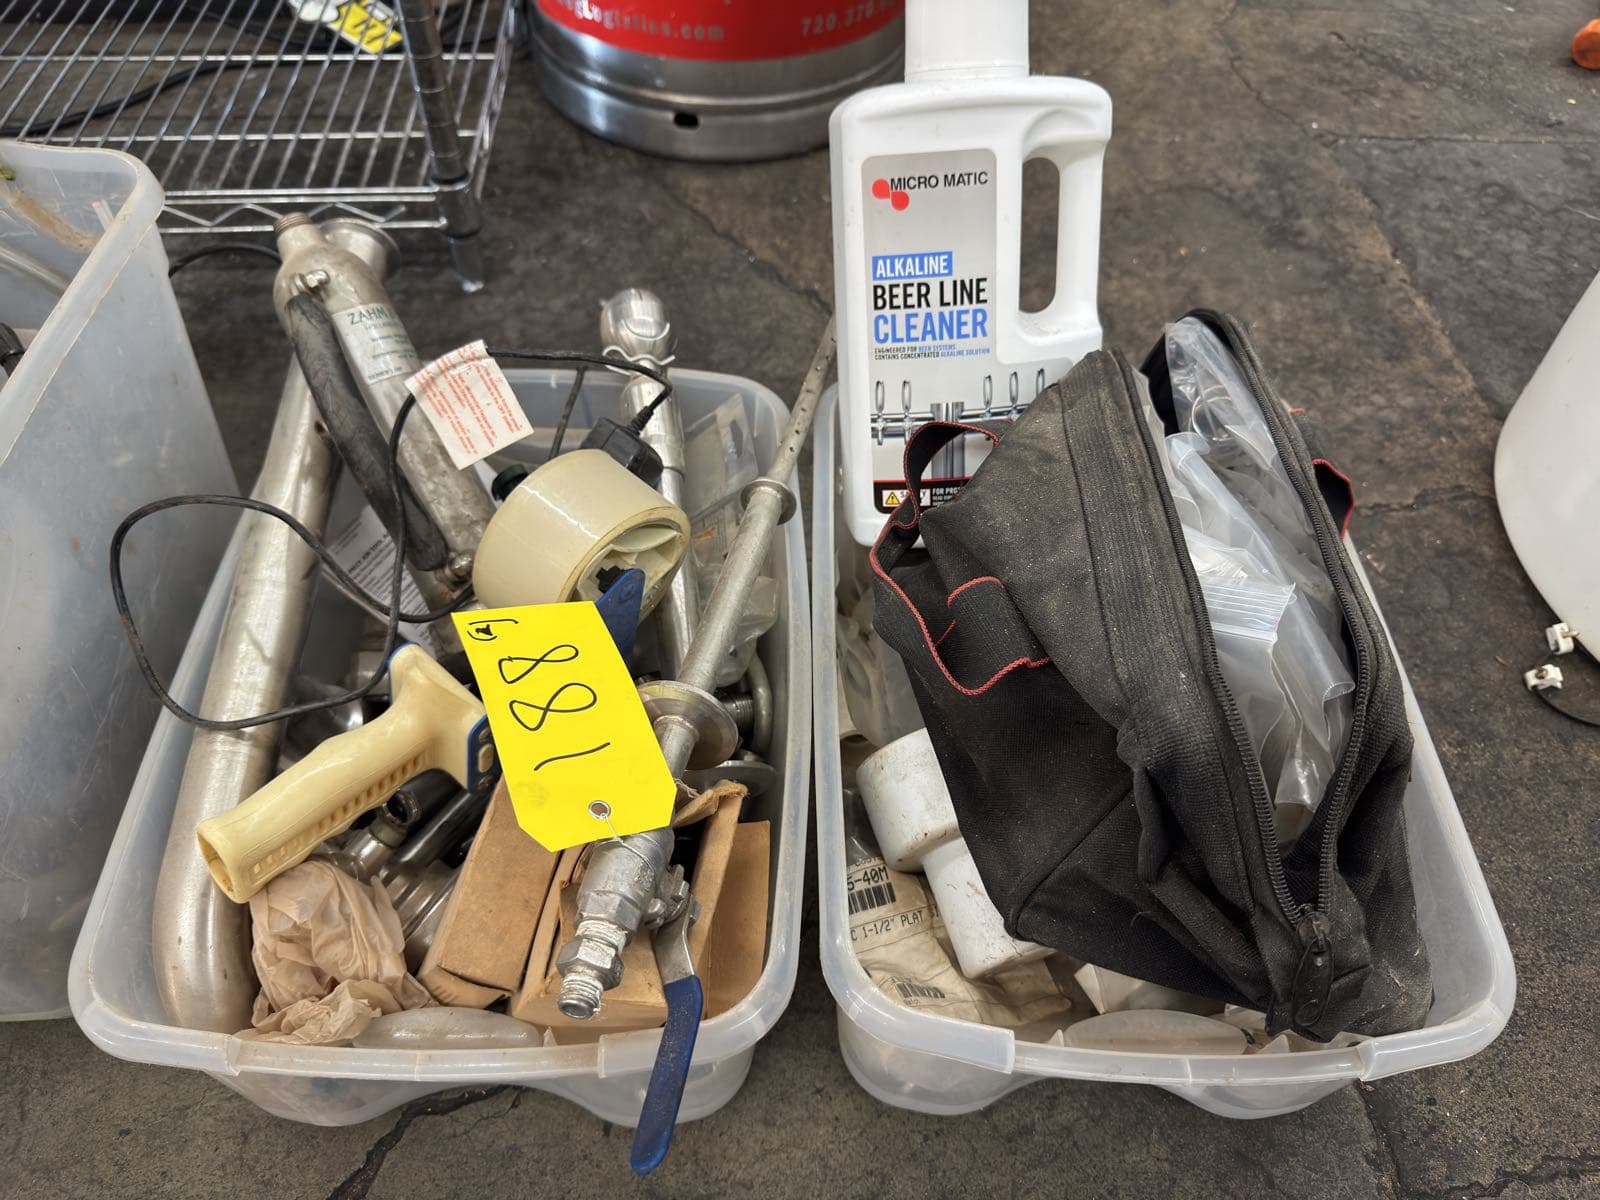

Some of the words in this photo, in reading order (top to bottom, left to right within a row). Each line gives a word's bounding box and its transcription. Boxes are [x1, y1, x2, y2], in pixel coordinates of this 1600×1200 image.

[890, 175, 939, 190] MICRO
[944, 171, 988, 188] MATIC
[876, 255, 949, 277] ALKALINE
[873, 282, 931, 311] BEER
[939, 278, 987, 307] LINE
[874, 309, 987, 344] CLEANER
[900, 351, 940, 360] CONCENTRATED
[498, 644, 611, 771] 188
[901, 910, 923, 927] PLAT
